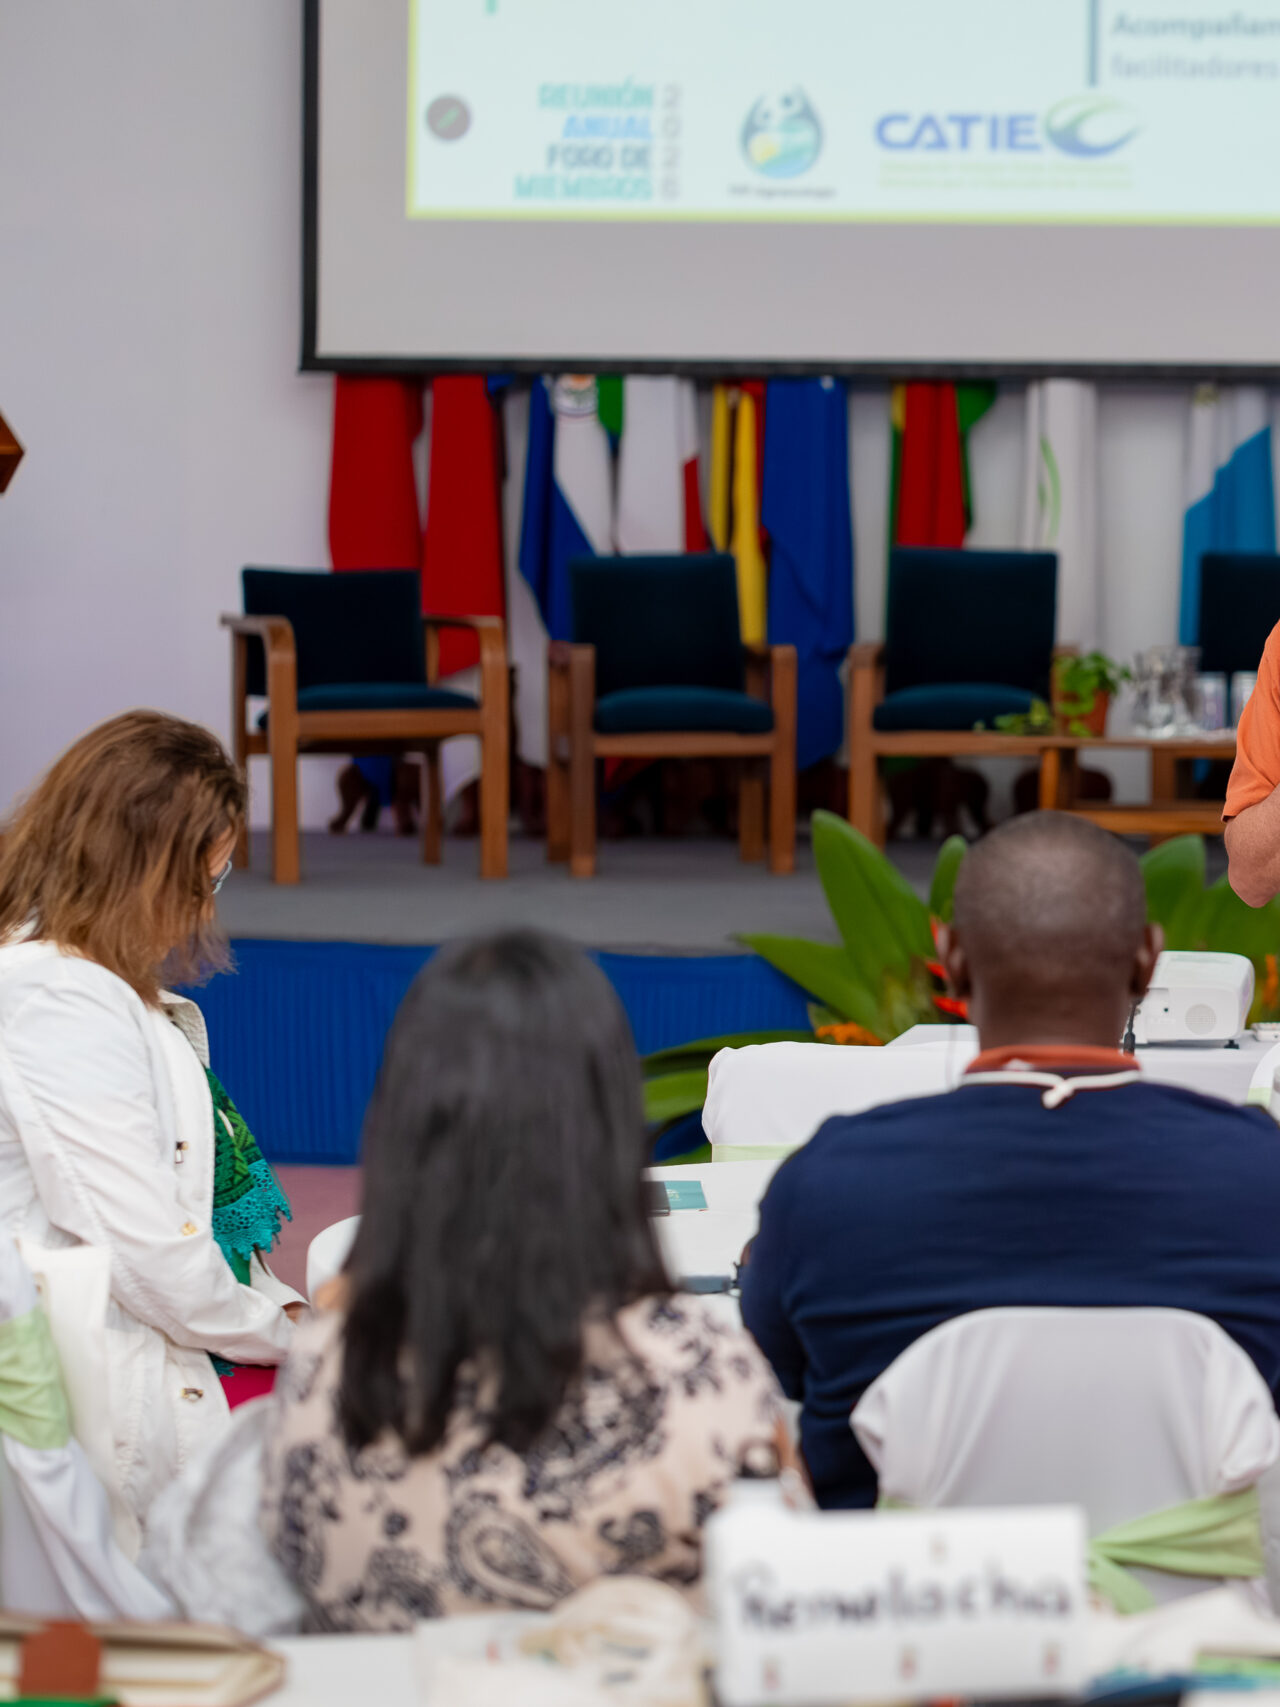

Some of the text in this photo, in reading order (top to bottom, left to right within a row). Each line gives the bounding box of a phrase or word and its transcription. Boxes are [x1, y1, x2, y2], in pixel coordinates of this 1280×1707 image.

[1110, 51, 1278, 78] facilitadores
[874, 112, 1042, 151] CATIE
[547, 143, 650, 168] FORO DE
